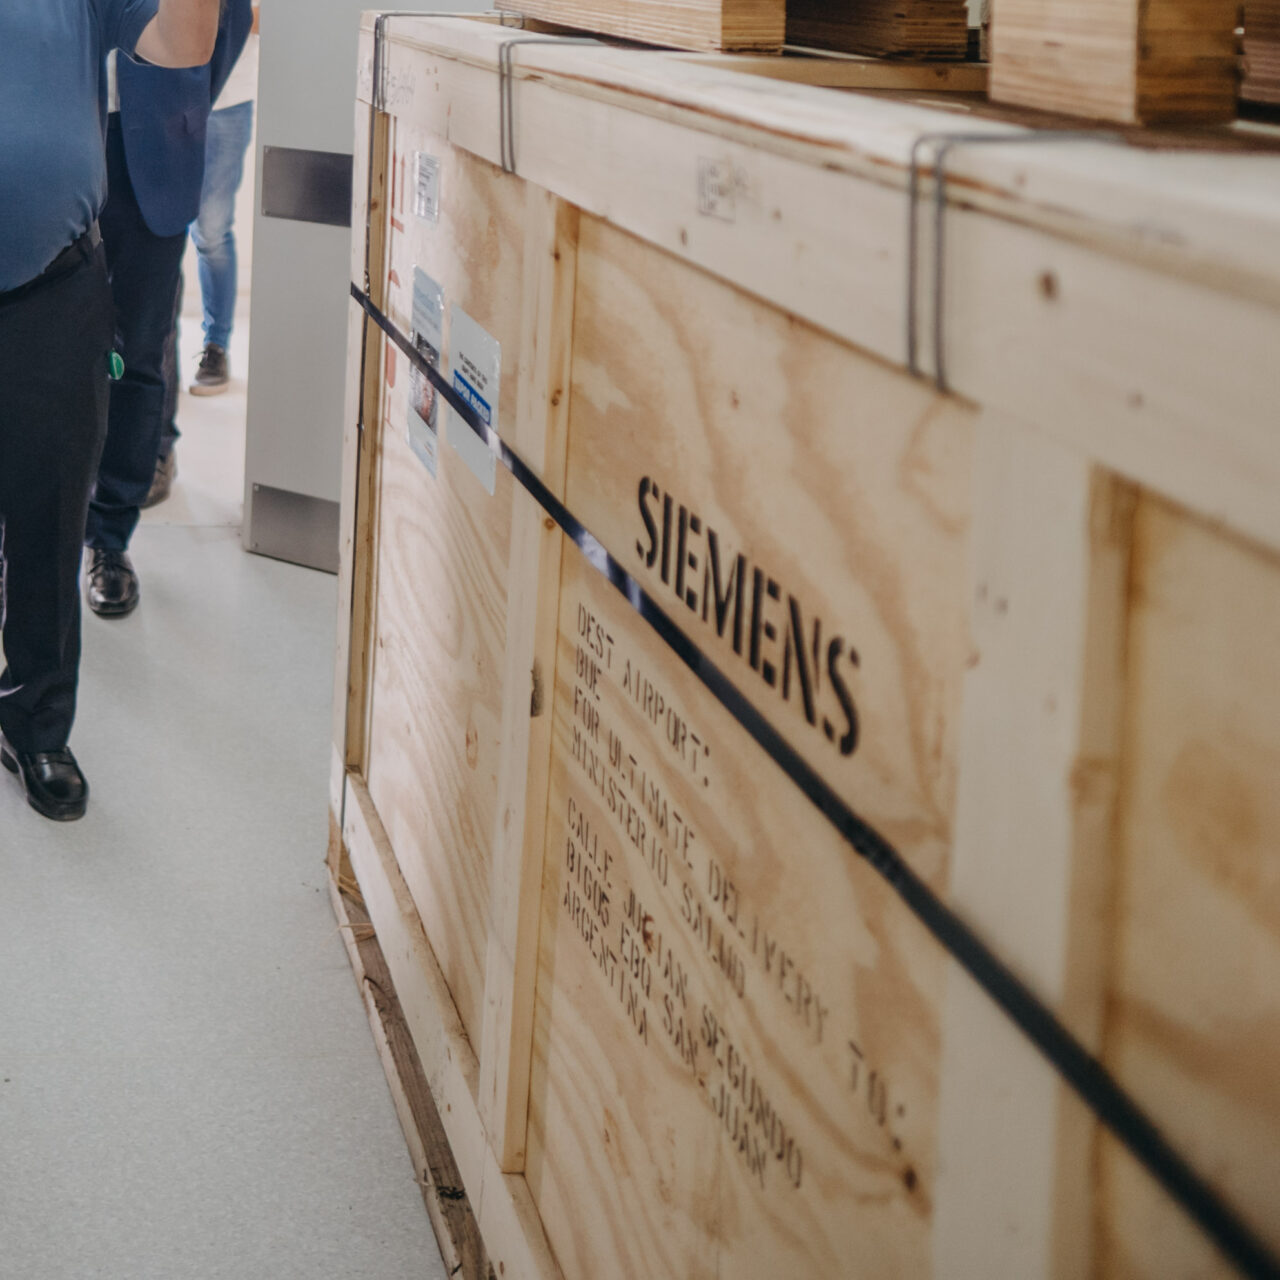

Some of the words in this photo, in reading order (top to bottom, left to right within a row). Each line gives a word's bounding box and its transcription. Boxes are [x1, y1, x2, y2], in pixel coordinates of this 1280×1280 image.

[576, 642, 602, 701] BUE
[578, 602, 615, 669] DEST
[623, 659, 710, 788] AIRPORT:
[636, 476, 861, 757] SIEMENS
[572, 724, 669, 888] MINISTERIO
[574, 684, 600, 744] FOR
[609, 728, 695, 870] ULTIMATE
[708, 858, 828, 1045] DELIVERY
[563, 880, 648, 1047] ARGENTINA
[567, 797, 614, 890] CALLE
[700, 1004, 803, 1190] SEGUNDO
